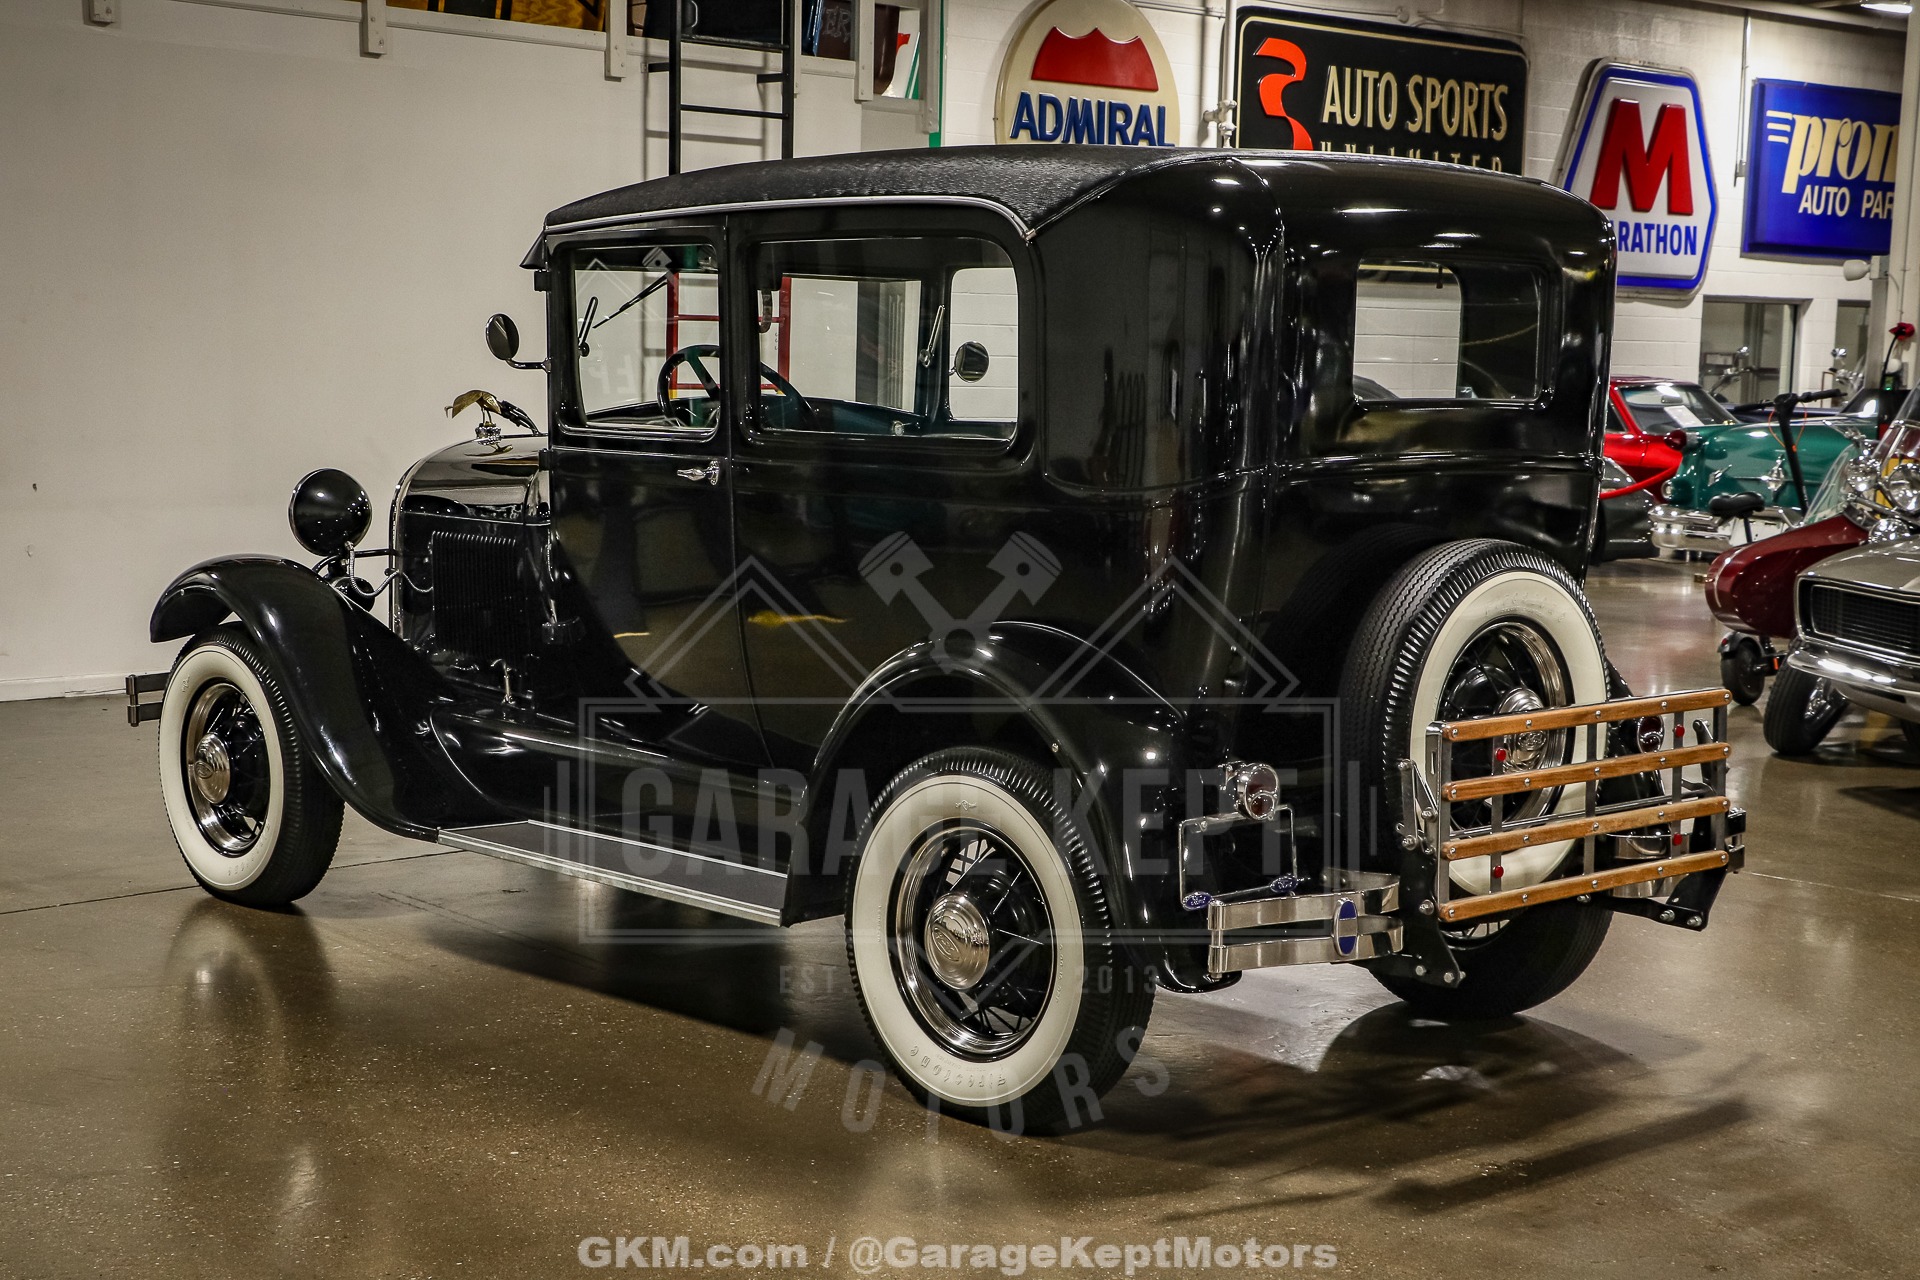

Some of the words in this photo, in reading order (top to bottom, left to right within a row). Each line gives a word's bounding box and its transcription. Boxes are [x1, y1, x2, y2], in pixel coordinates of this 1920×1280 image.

[1009, 91, 1176, 147] ADMIRAL
[1321, 65, 1398, 131] AUTO
[1406, 74, 1509, 141] SPORTS
[1590, 97, 1694, 216] M
[1798, 184, 1850, 217] AUTO
[1611, 220, 1697, 256] RATHON
